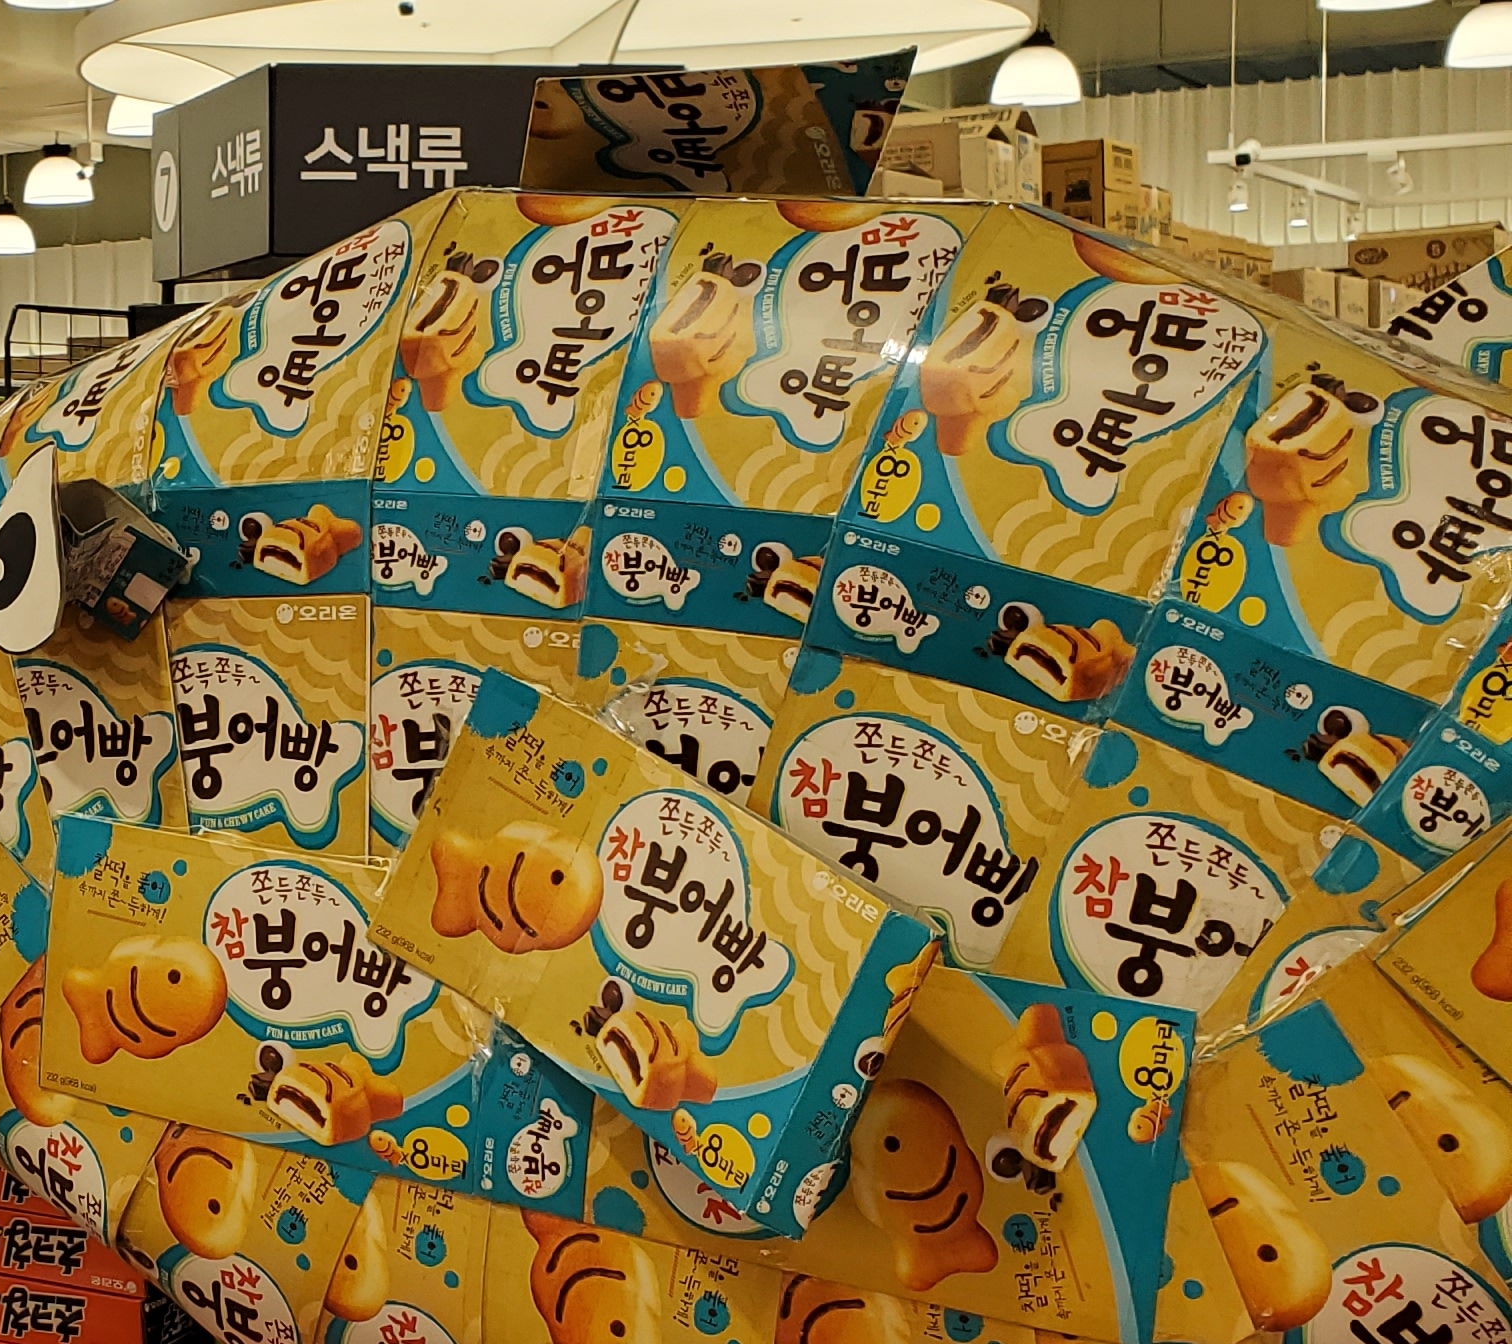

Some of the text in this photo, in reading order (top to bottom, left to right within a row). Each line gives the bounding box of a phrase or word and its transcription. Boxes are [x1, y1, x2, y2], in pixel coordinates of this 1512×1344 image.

[210, 129, 262, 200] 스낵류
[299, 124, 468, 189] 스낵류
[158, 167, 173, 215] 7
[515, 209, 646, 405] 참붕어빵
[780, 217, 921, 418] 참붕어빵
[1054, 289, 1223, 479] 참붕어빵
[618, 506, 655, 519] 오리온
[603, 550, 691, 594] 참붕어빵
[859, 538, 900, 555] 오리온
[299, 604, 358, 623] 오리온
[836, 581, 930, 639] 참붕어빵
[1150, 658, 1243, 730] 참붕어빵
[609, 824, 775, 977] 참붕어빵
[827, 882, 880, 924] 오리온
[211, 906, 412, 1020] 참붕어빵
[0, 1284, 88, 1343] 초코칩
